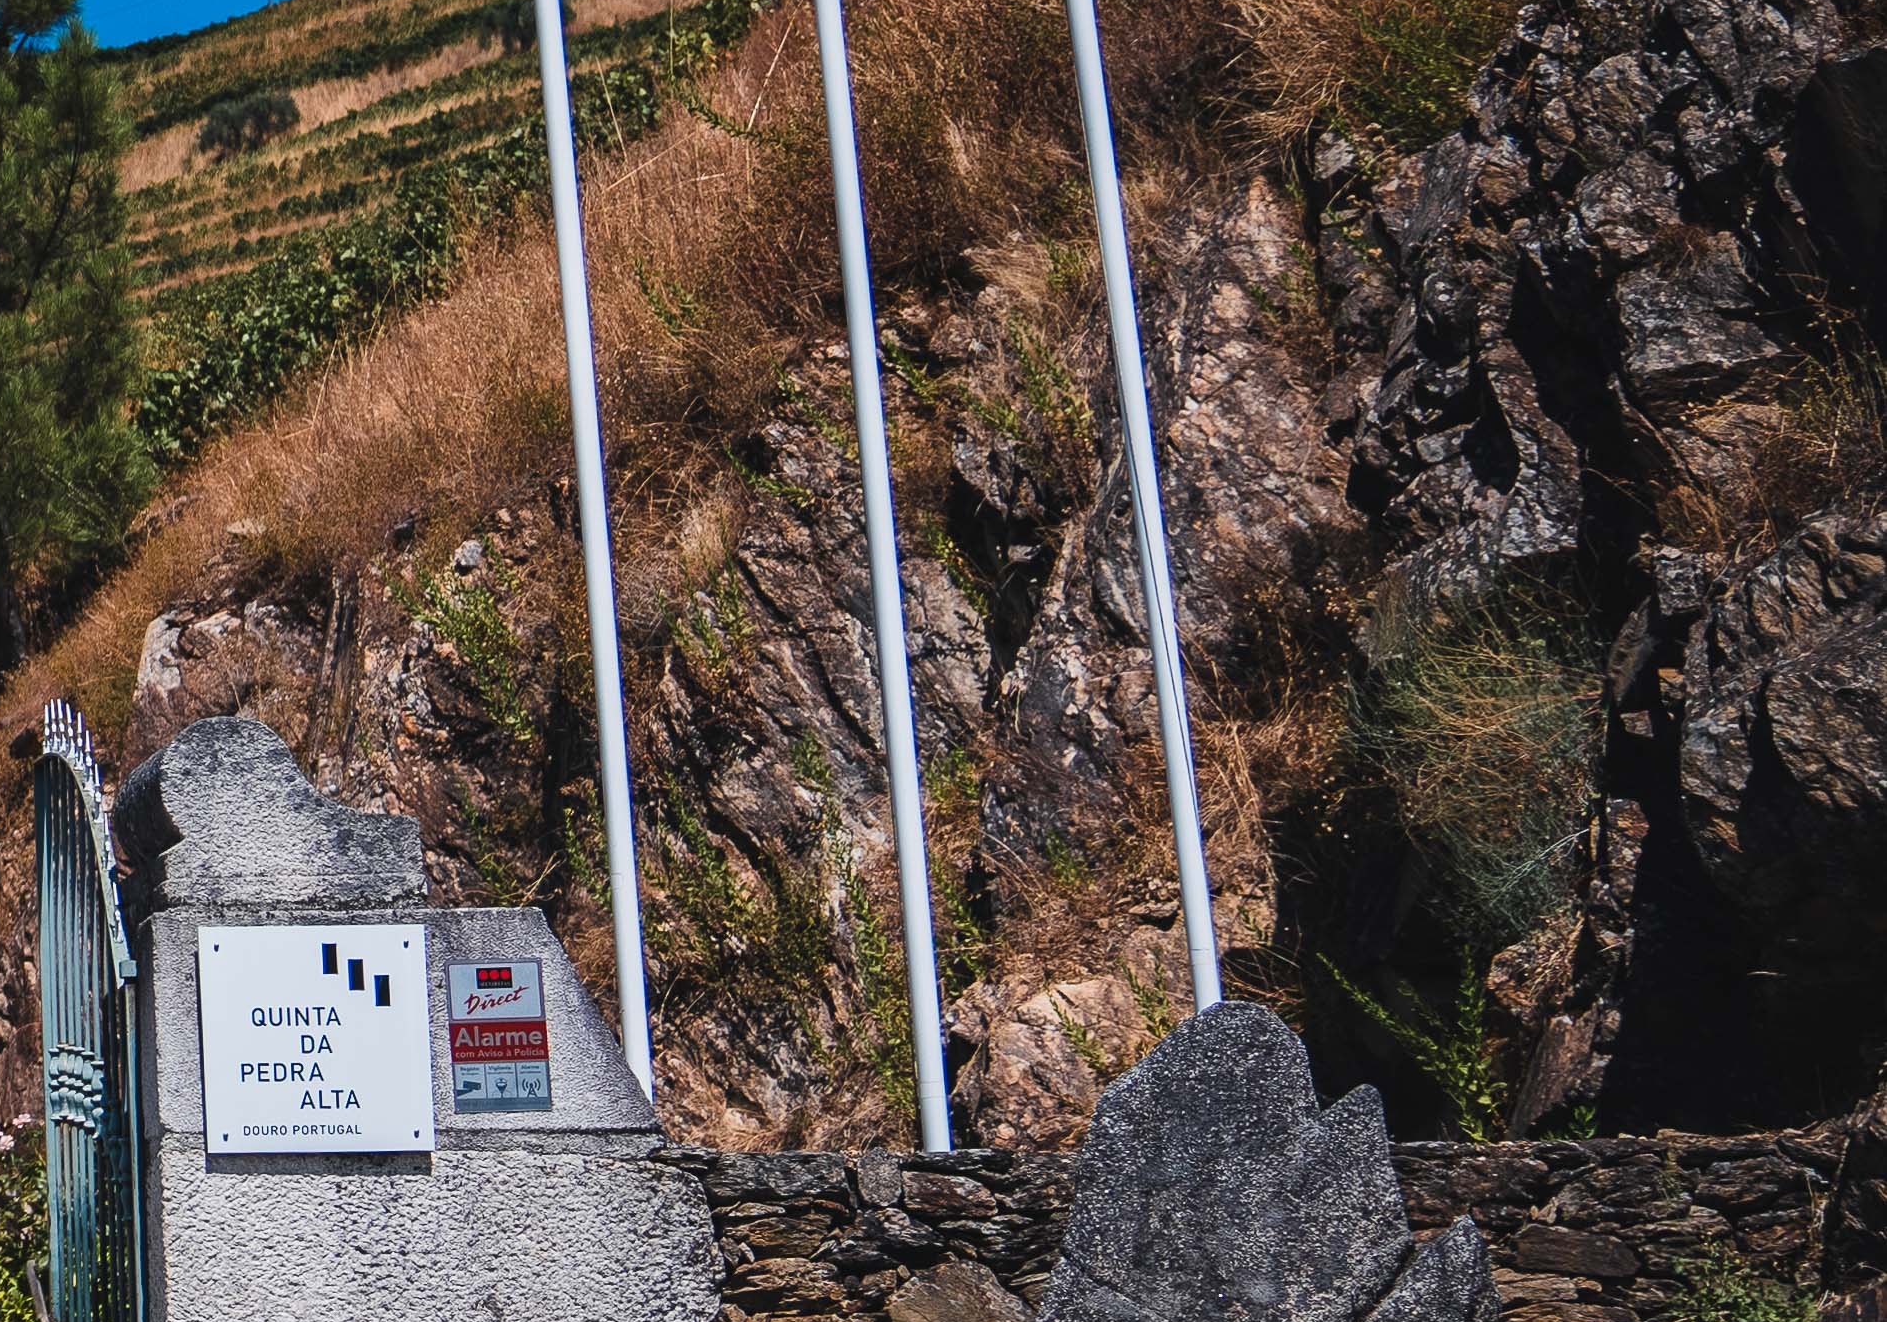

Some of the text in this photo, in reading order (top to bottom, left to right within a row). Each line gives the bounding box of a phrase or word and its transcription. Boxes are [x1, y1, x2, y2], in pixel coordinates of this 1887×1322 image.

[464, 986, 529, 1015] Direct
[251, 1007, 341, 1027] QUINTA
[301, 1035, 333, 1054] DA
[455, 1026, 543, 1047] Alarme
[477, 1049, 503, 1058] Aviso
[506, 1048, 512, 1057] à
[240, 1062, 324, 1082] PEDRA
[300, 1089, 361, 1109] ALTA
[243, 1124, 362, 1136] DOURO PORTUGAL
